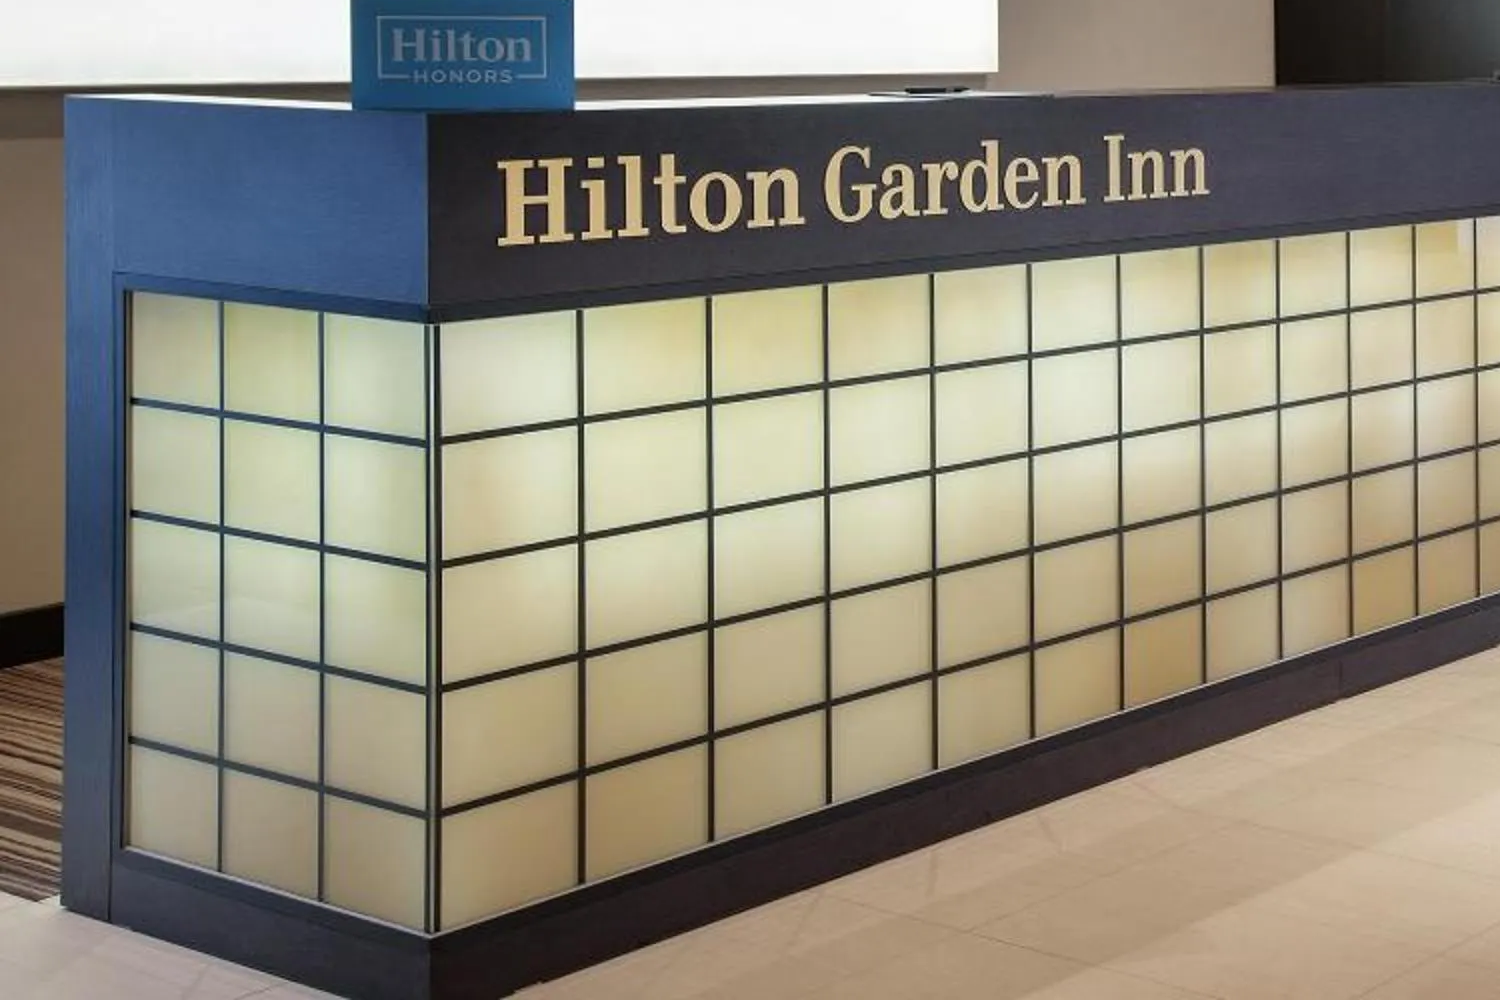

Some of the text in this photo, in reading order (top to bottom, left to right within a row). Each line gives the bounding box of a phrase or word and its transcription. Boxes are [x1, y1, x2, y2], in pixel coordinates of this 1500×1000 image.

[392, 28, 532, 62] Hilton
[413, 69, 513, 84] HONORS
[497, 134, 1211, 247] Hilton Garden Inn
